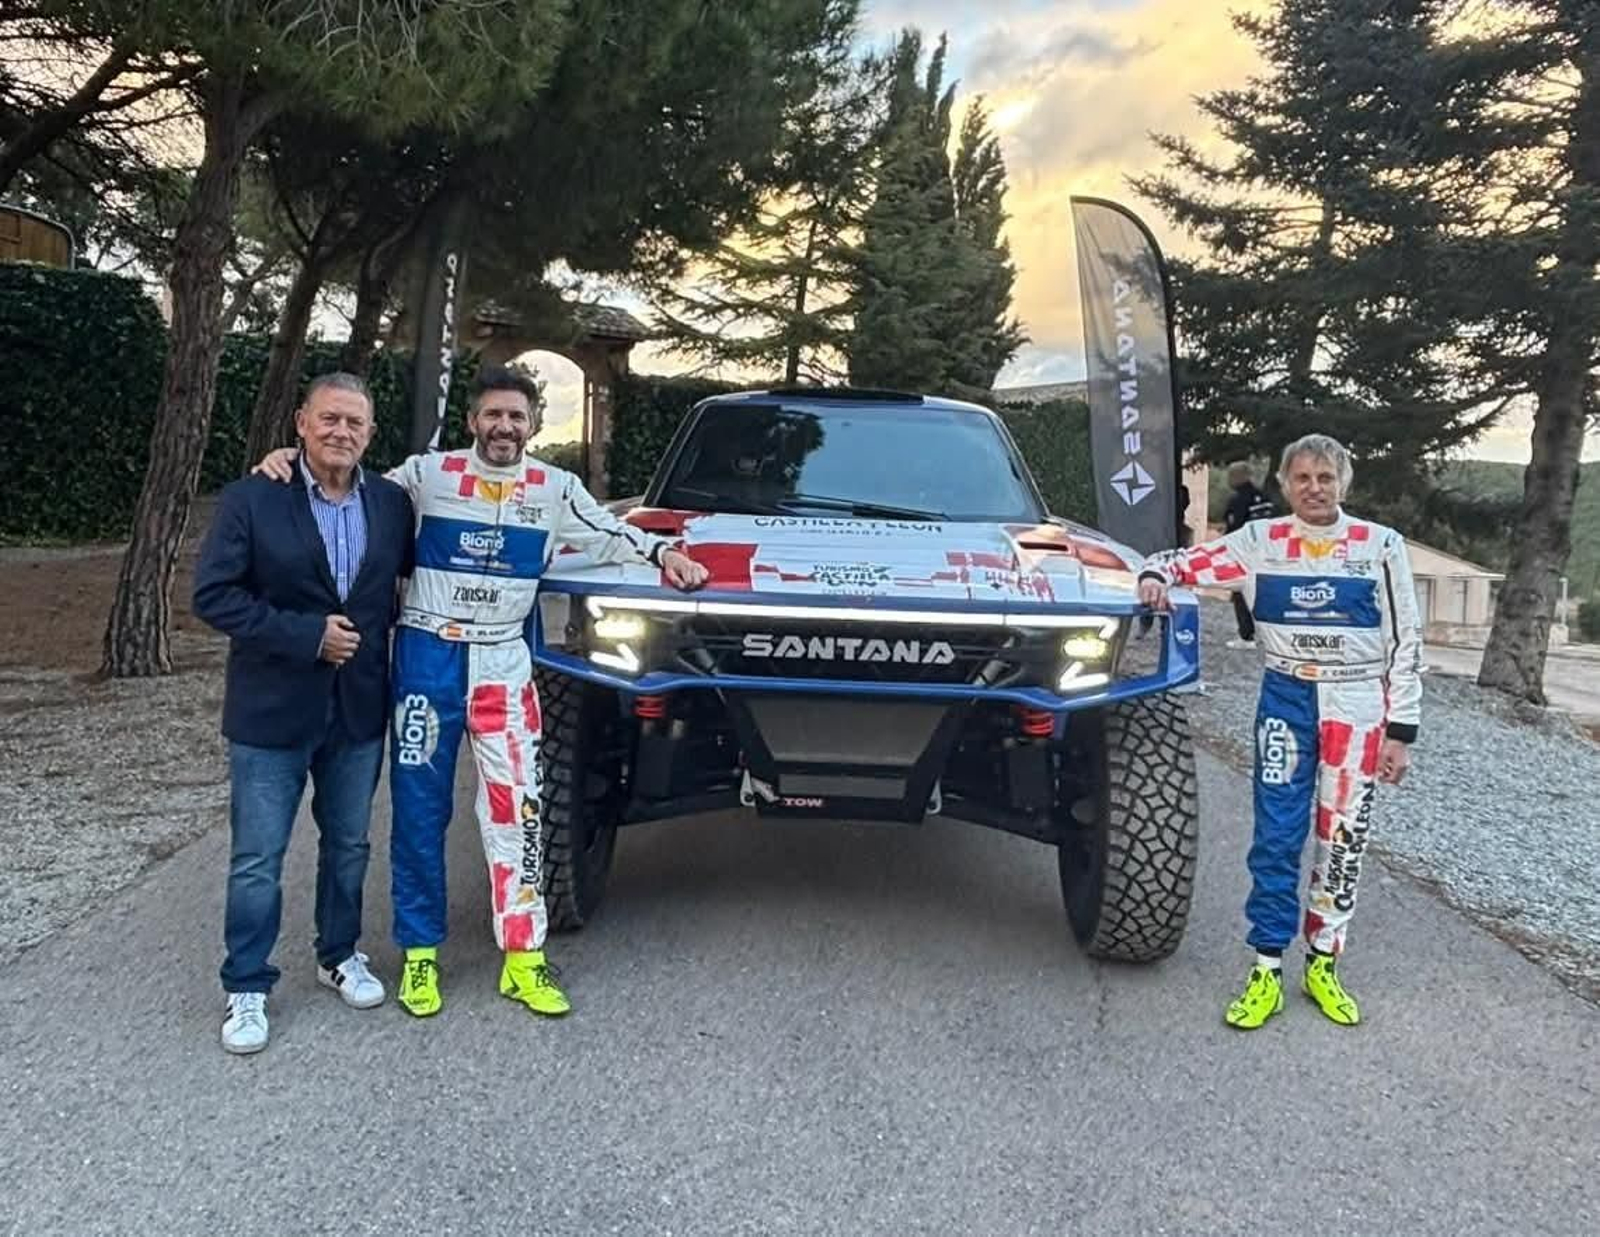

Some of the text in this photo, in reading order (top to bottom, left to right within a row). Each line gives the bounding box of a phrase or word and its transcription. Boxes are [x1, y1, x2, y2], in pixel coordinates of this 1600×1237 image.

[1290, 585, 1336, 601] Bion3
[743, 633, 955, 665] SANTANA
[399, 694, 429, 765] Bion3
[1262, 717, 1287, 784] Bion3
[783, 797, 824, 807] TOW
